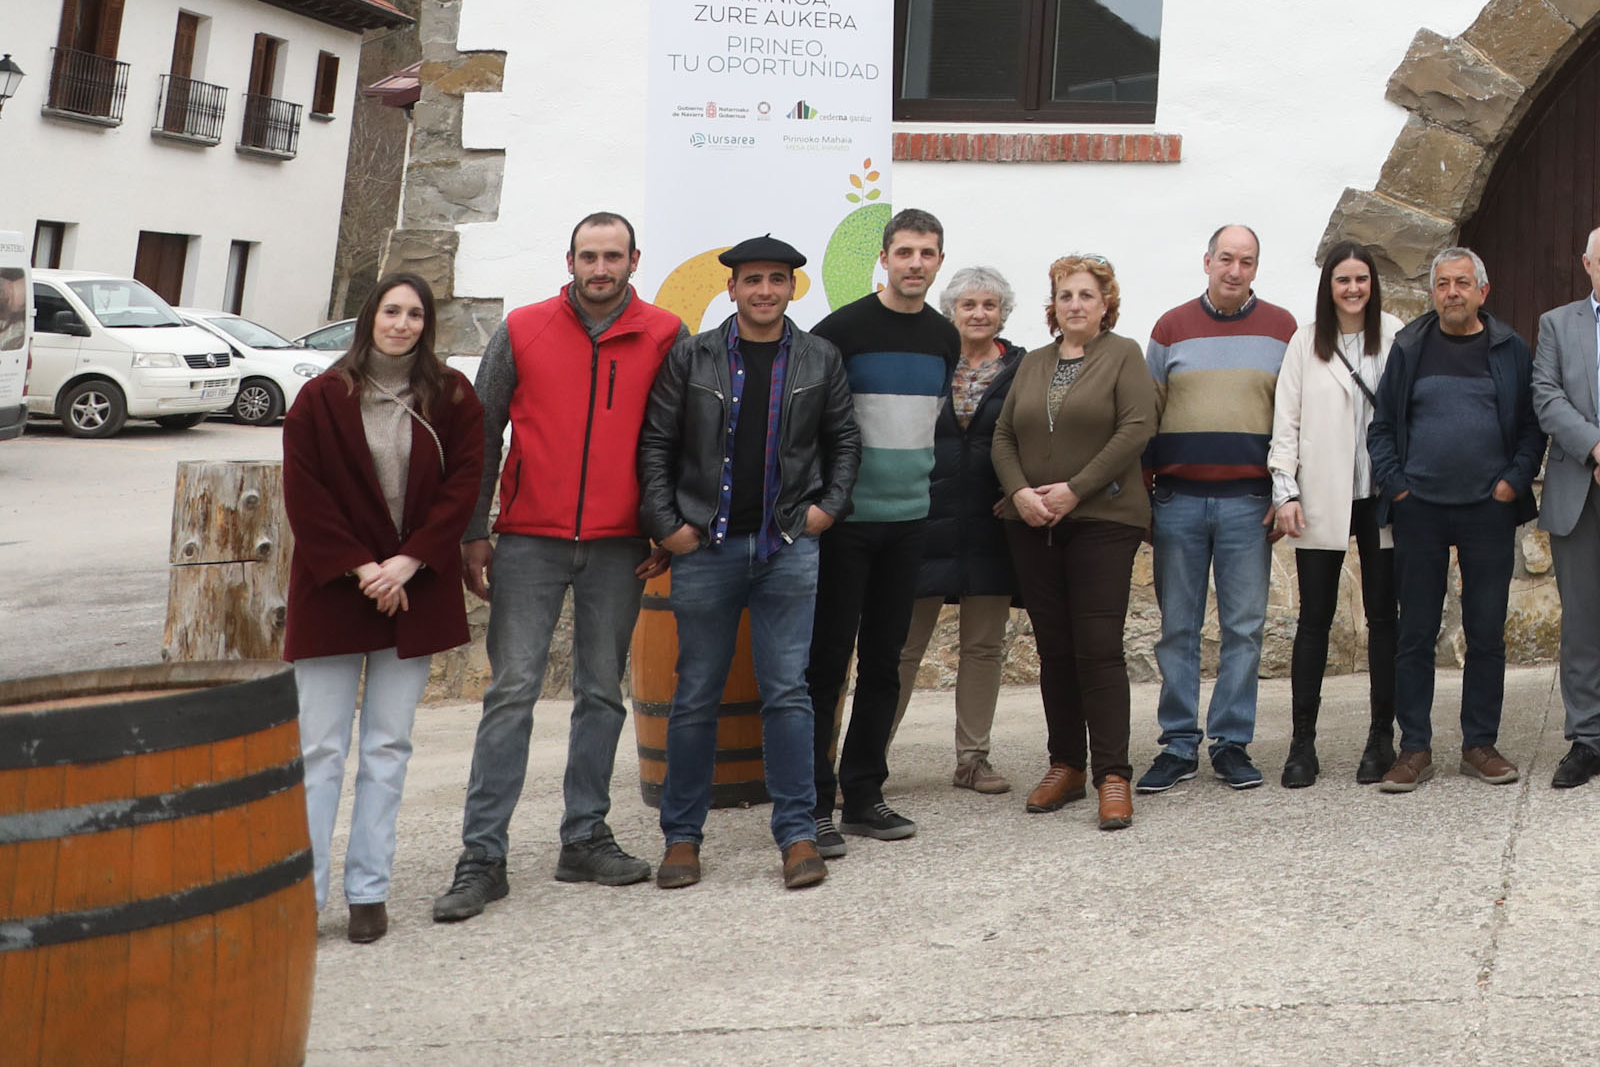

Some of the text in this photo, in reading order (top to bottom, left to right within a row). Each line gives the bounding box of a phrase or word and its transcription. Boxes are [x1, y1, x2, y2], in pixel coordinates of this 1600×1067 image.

[694, 4, 858, 31] ZURE AUKERA
[727, 35, 827, 59] PIRINEO,
[667, 54, 880, 81] TU OPORTUNIDAD
[707, 133, 756, 145] lursarea
[783, 134, 853, 144] Pirinioko Mahaia
